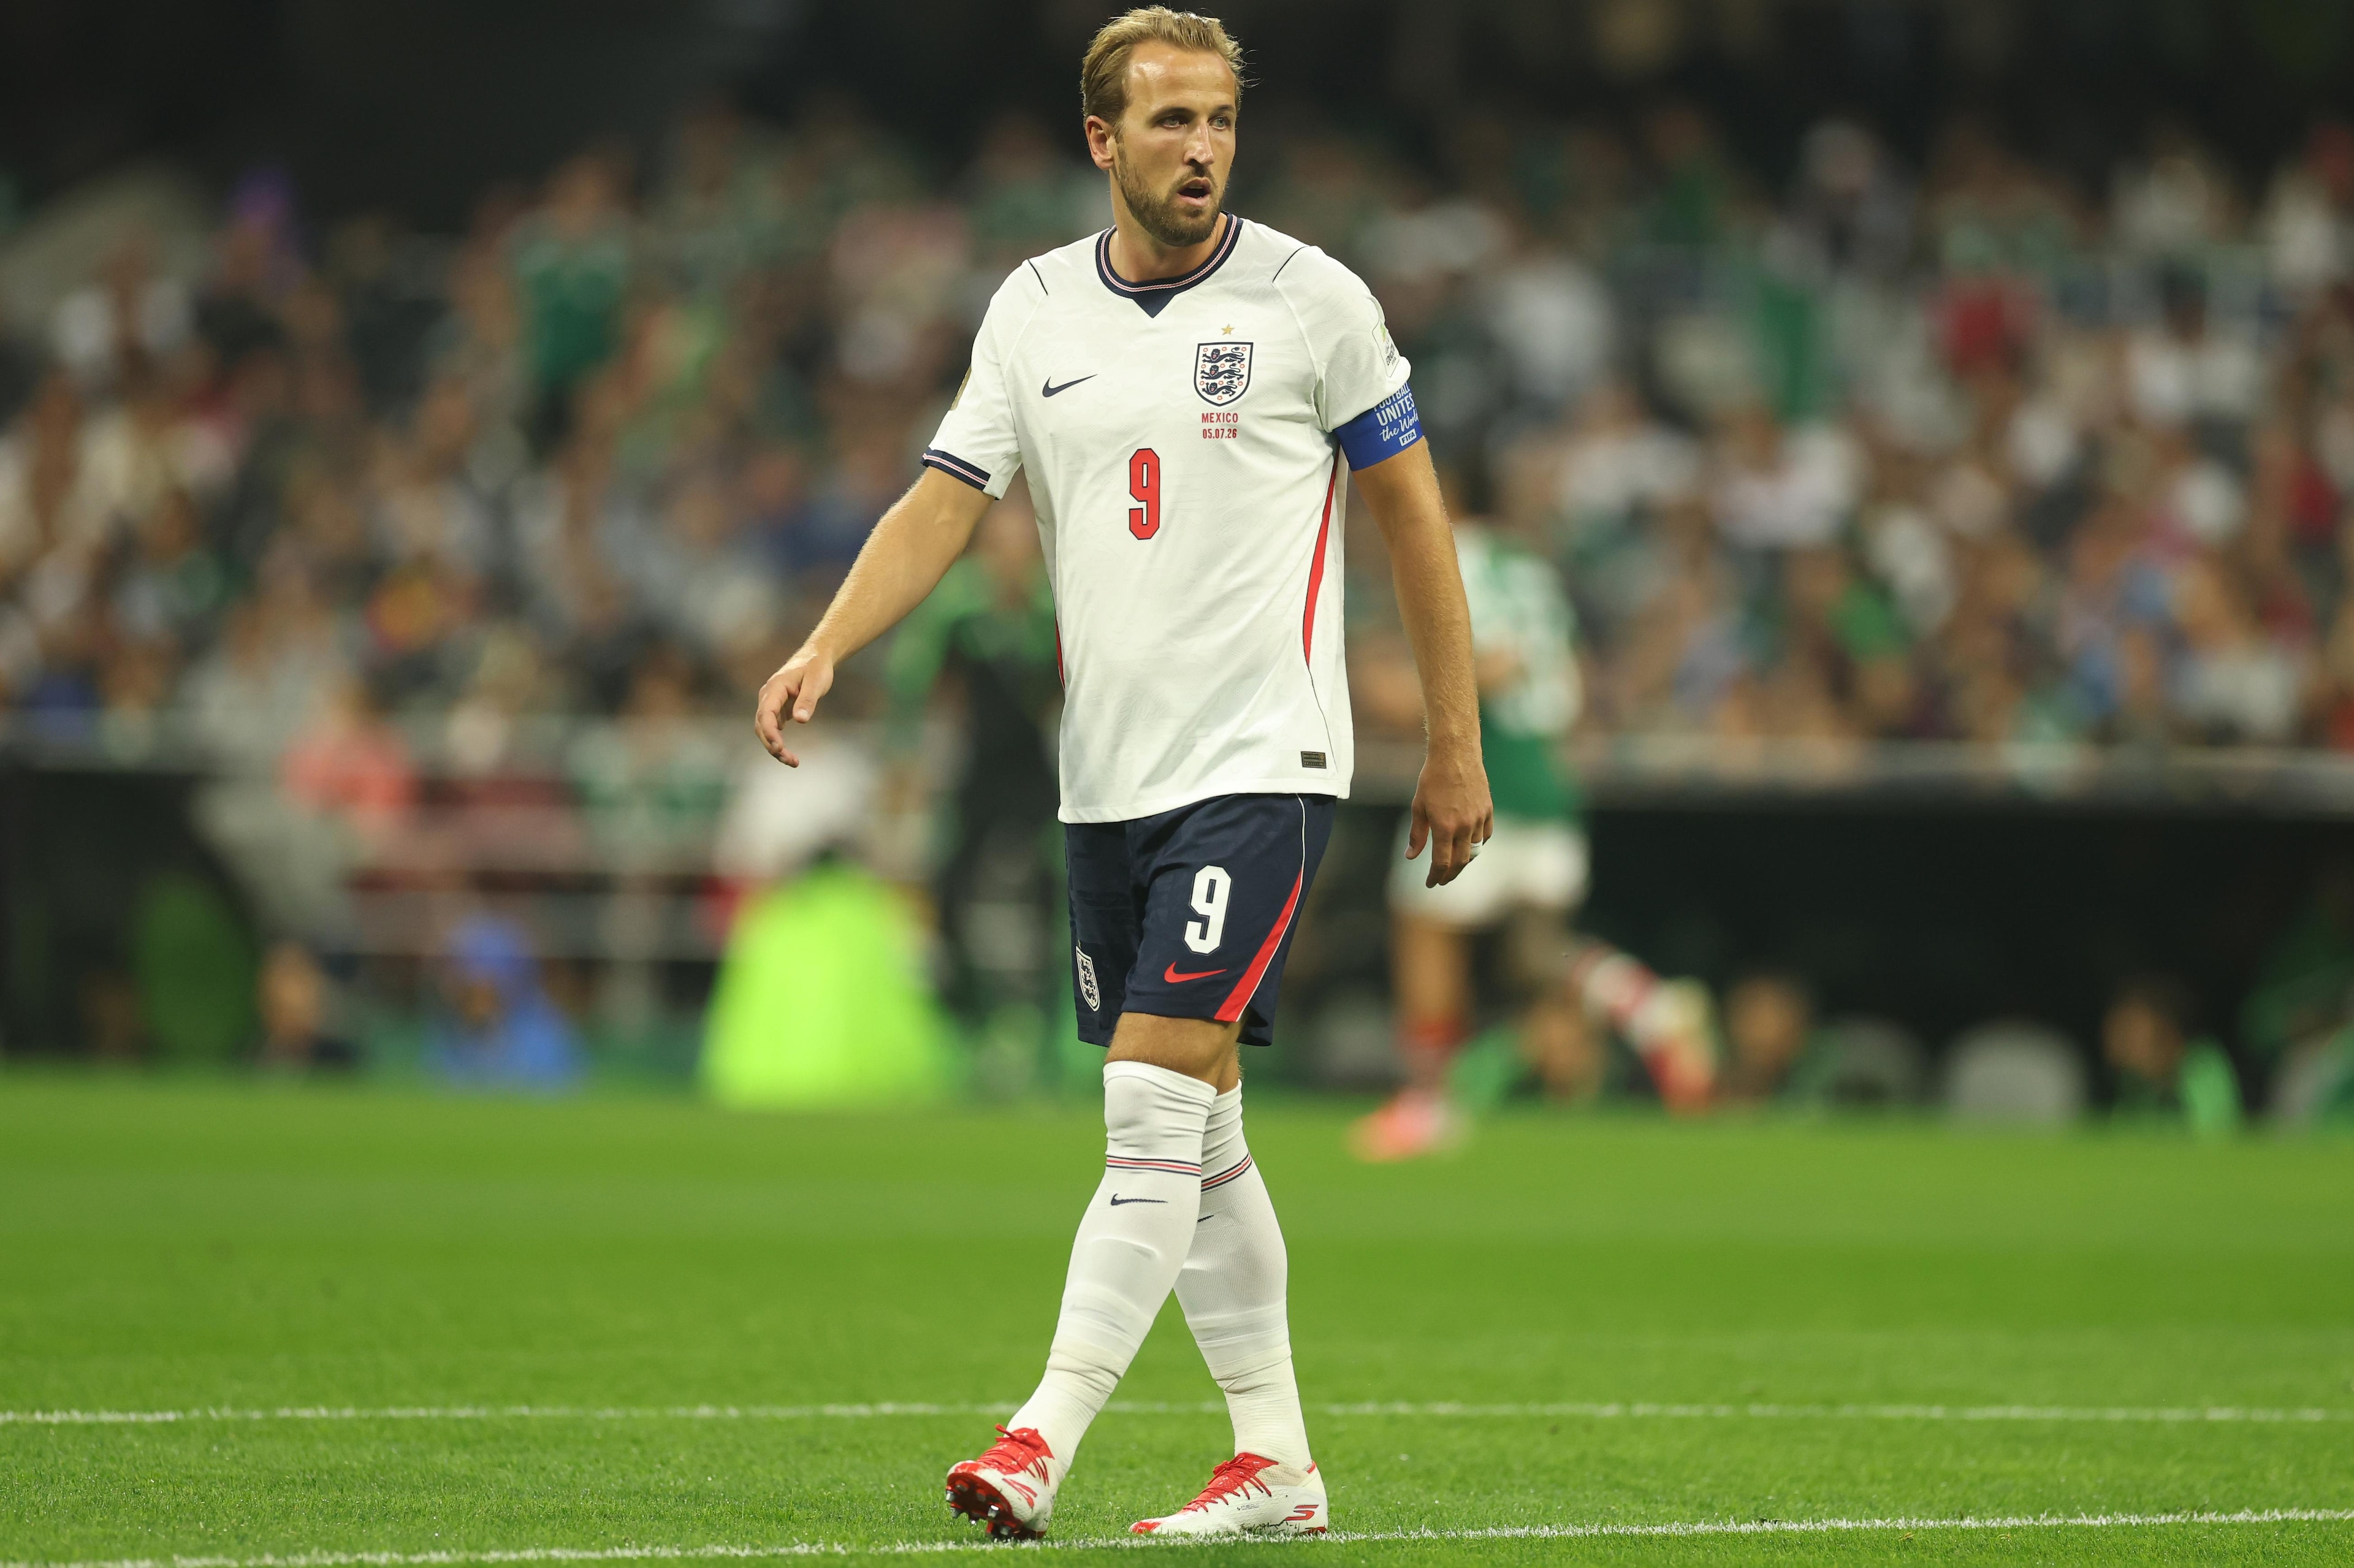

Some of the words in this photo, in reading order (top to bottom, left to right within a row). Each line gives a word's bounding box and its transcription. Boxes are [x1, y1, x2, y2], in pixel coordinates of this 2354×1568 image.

[1376, 392, 1414, 426] UNITES
[1202, 413, 1238, 423] MEXICO
[1203, 428, 1237, 439] 05.07.26
[1379, 426, 1399, 441] the
[1401, 431, 1415, 444] FIFA
[1129, 448, 1160, 540] 9
[1183, 864, 1232, 955] 9
